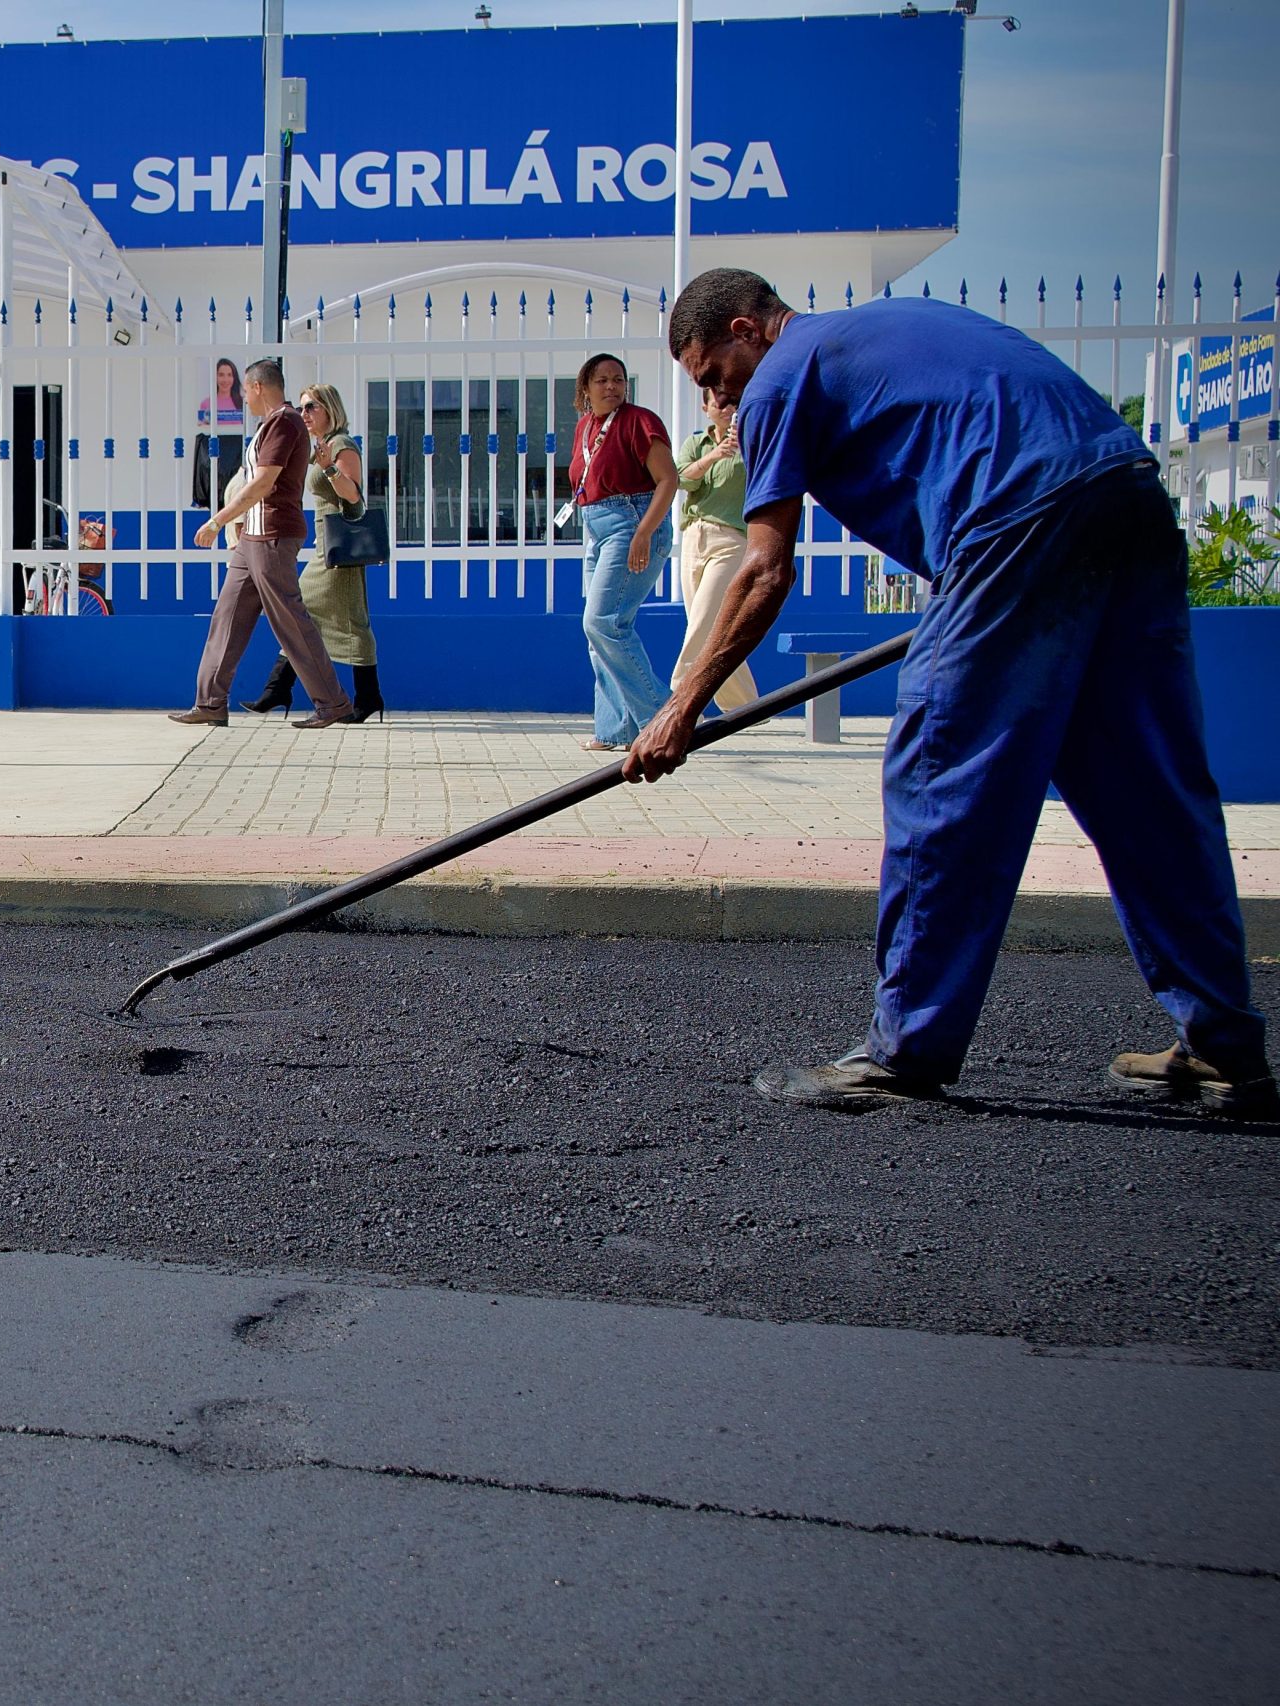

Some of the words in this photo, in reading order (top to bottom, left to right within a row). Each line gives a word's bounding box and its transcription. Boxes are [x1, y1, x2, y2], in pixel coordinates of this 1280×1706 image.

[131, 129, 563, 214] SHANGRILÁ
[576, 141, 789, 203] ROSA
[1197, 357, 1255, 415] SHANGILÁ
